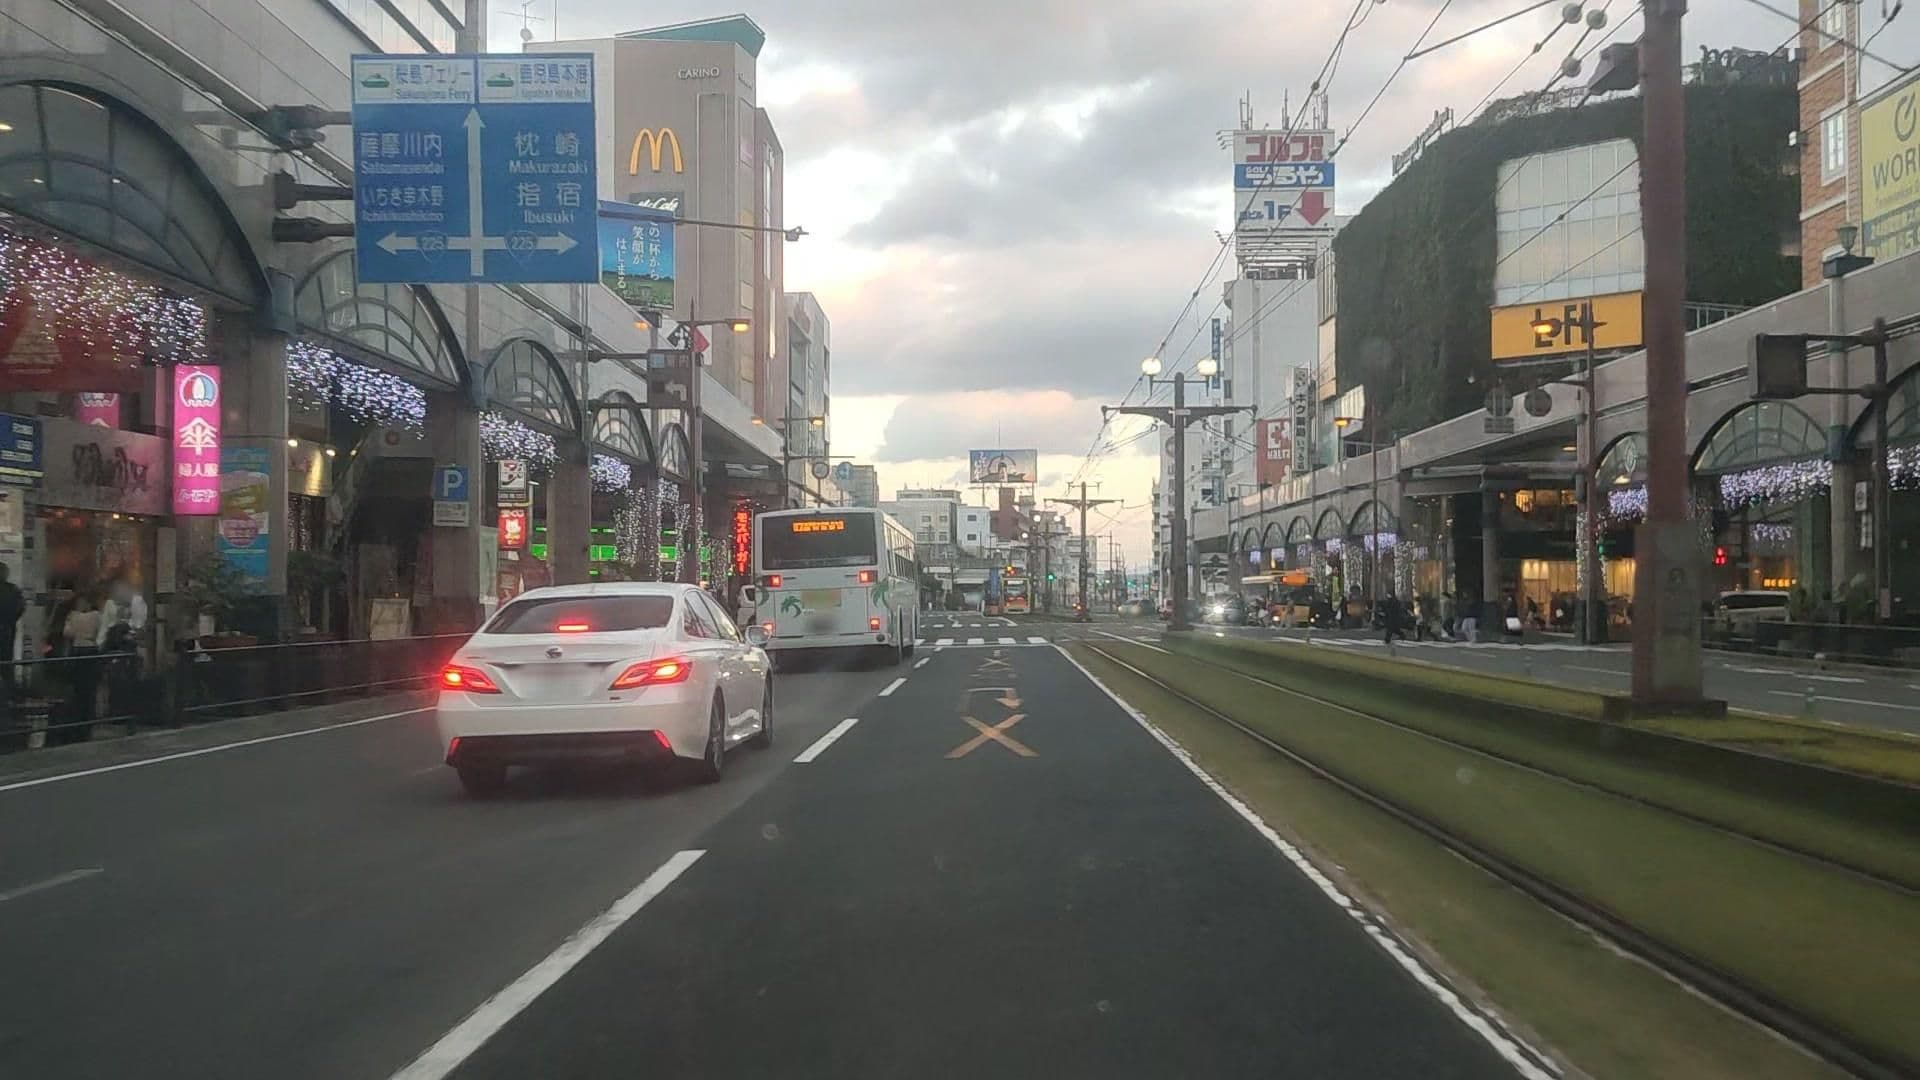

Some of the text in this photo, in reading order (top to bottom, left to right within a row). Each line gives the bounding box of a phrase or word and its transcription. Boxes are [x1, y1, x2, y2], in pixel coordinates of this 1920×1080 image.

[677, 66, 720, 81] CARINO
[449, 88, 472, 101] Ferry
[360, 131, 443, 158] 薩摩川内
[508, 160, 588, 174] Makurazaki
[360, 185, 444, 207] いちき串木野
[523, 210, 575, 224] Ibusuki
[511, 236, 535, 250] 225
[178, 416, 218, 456] 傘
[444, 470, 463, 497] P
